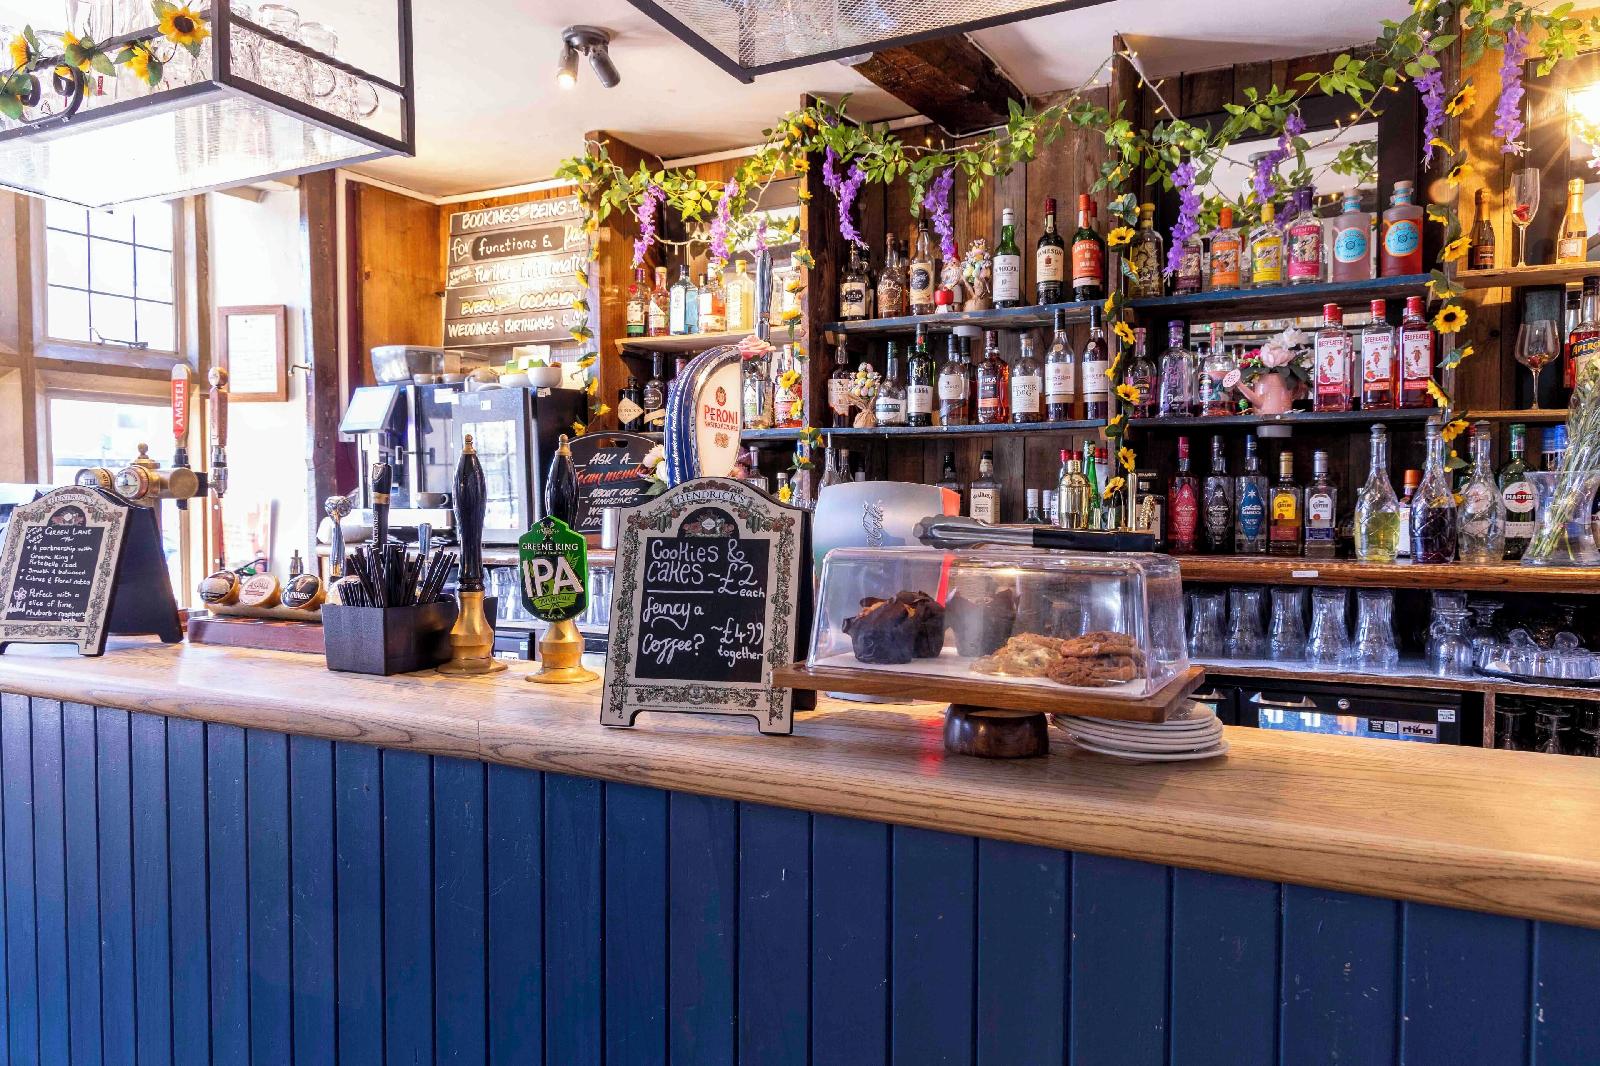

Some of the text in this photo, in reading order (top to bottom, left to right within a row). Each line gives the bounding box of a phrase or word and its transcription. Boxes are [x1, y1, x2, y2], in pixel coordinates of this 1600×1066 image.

[461, 208, 520, 229] BOOKINGS
[529, 201, 567, 219] BEING
[451, 237, 474, 262] for
[478, 236, 538, 256] functions
[1037, 248, 1062, 258] JAMESON
[448, 320, 500, 338] WEDDINGS
[504, 315, 555, 333] BIRTHDAYS
[1573, 340, 1600, 355] APERO
[175, 381, 184, 427] AMSTEL
[704, 405, 738, 425] PERONI
[589, 452, 631, 465] ASK A
[589, 488, 640, 498] ABOUT OUR
[592, 497, 631, 505] AMAZING
[676, 490, 748, 503] HENDRICK'S
[521, 543, 579, 551] GREENE KING
[652, 539, 747, 564] Cookies &
[522, 555, 584, 598] IPA
[647, 561, 704, 585] Cakes
[739, 588, 765, 598] each
[694, 606, 705, 615] a
[642, 634, 705, 665] Coffee?
[718, 646, 764, 668] together
[1402, 724, 1434, 735] rhino
